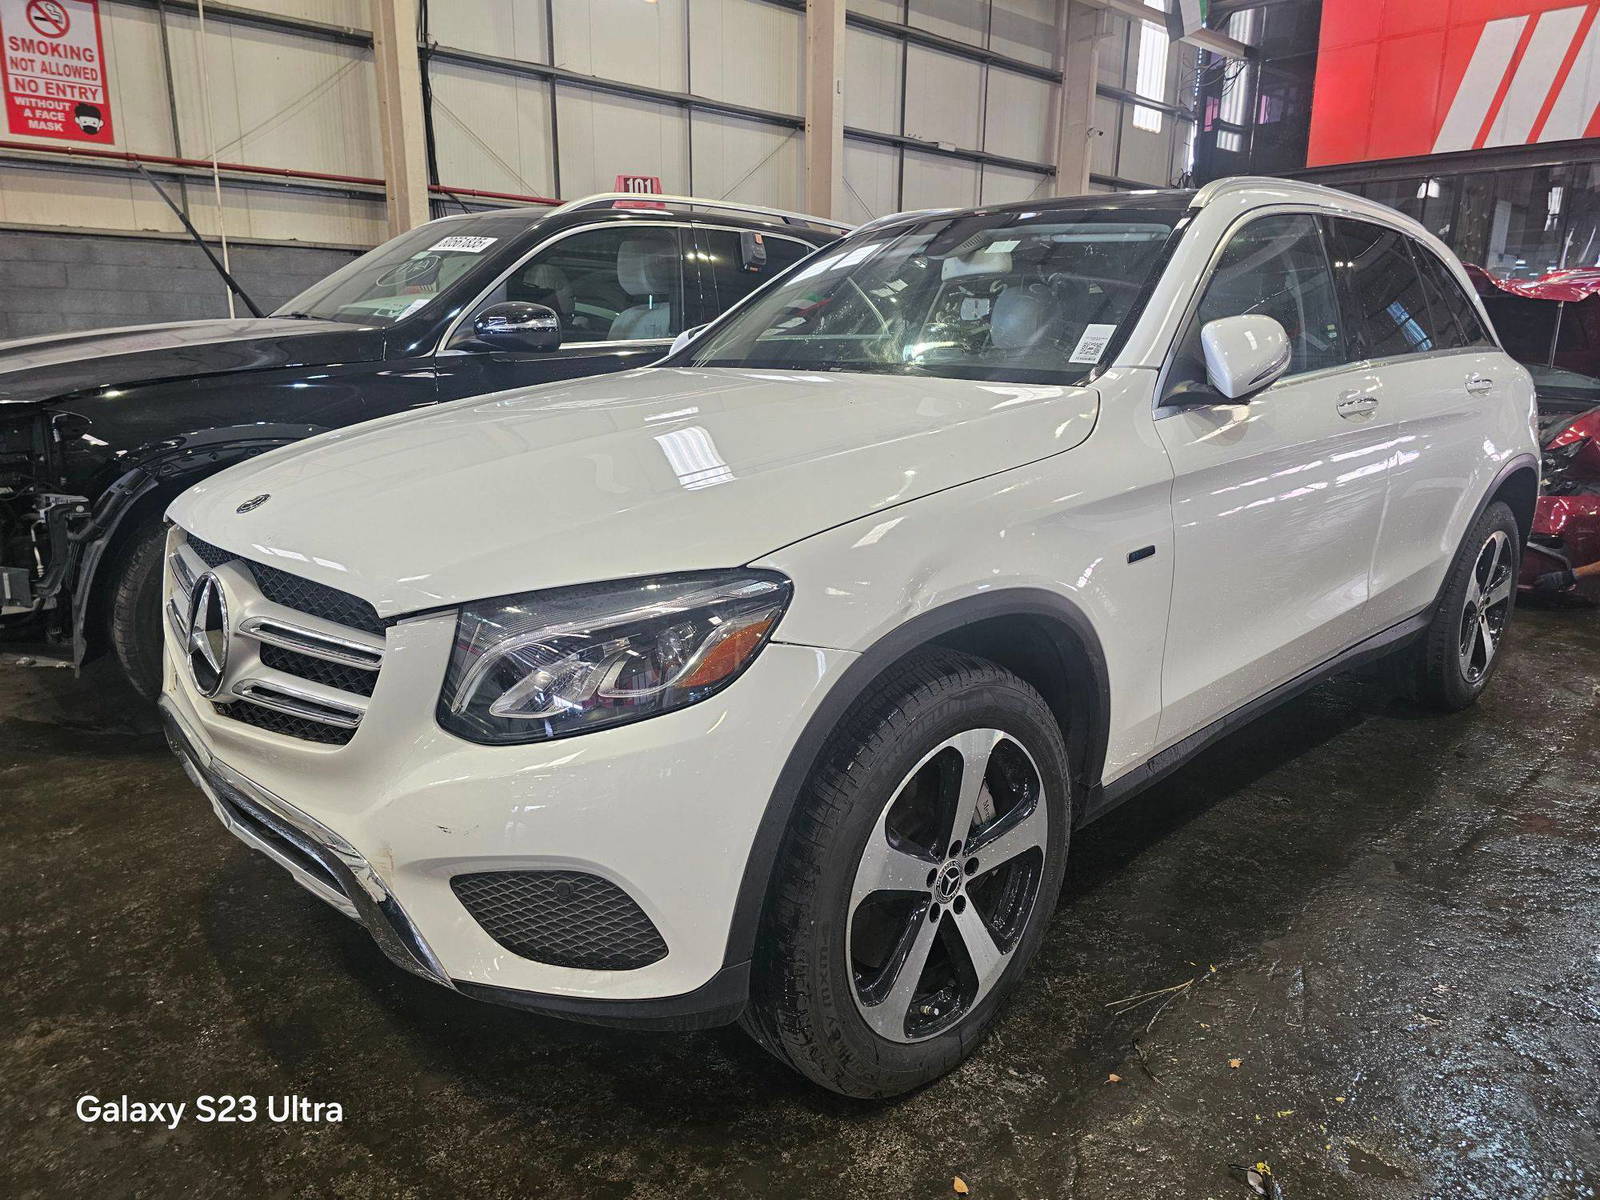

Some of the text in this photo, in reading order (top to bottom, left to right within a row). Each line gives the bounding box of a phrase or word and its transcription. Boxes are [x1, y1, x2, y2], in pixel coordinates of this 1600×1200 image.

[9, 36, 95, 63] SMOKING
[9, 56, 98, 81] NOT ALLOWED
[15, 78, 98, 101] NO ENTRY
[13, 96, 71, 111] WITHOUT
[23, 108, 66, 121] A FACE
[28, 120, 64, 132] MASK
